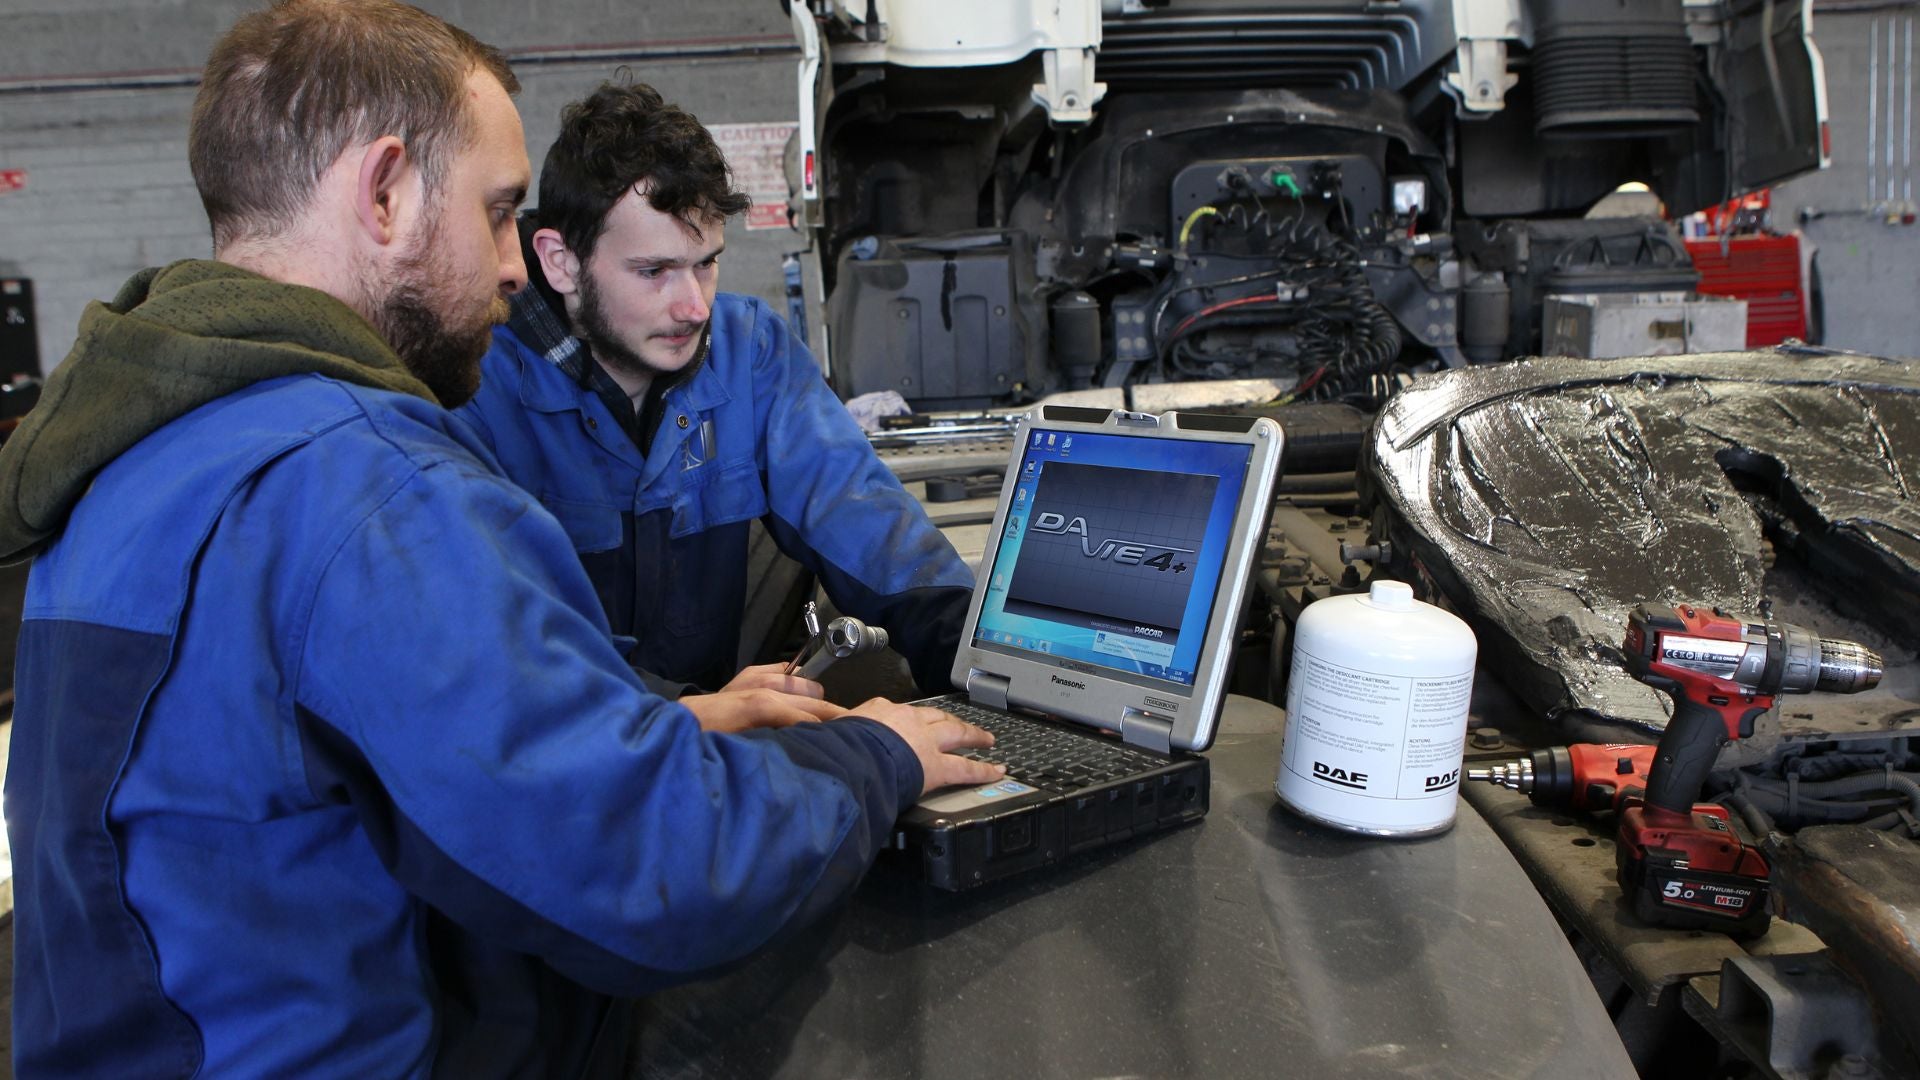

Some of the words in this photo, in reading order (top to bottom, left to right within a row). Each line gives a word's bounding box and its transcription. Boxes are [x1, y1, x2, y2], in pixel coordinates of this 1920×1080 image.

[1134, 626, 1163, 639] PACCAR
[1051, 674, 1086, 690] Panasonic
[1313, 761, 1368, 783] DAF
[1425, 768, 1459, 787] DAF
[1663, 881, 1695, 899] 5.0
[1716, 896, 1743, 906] M18
